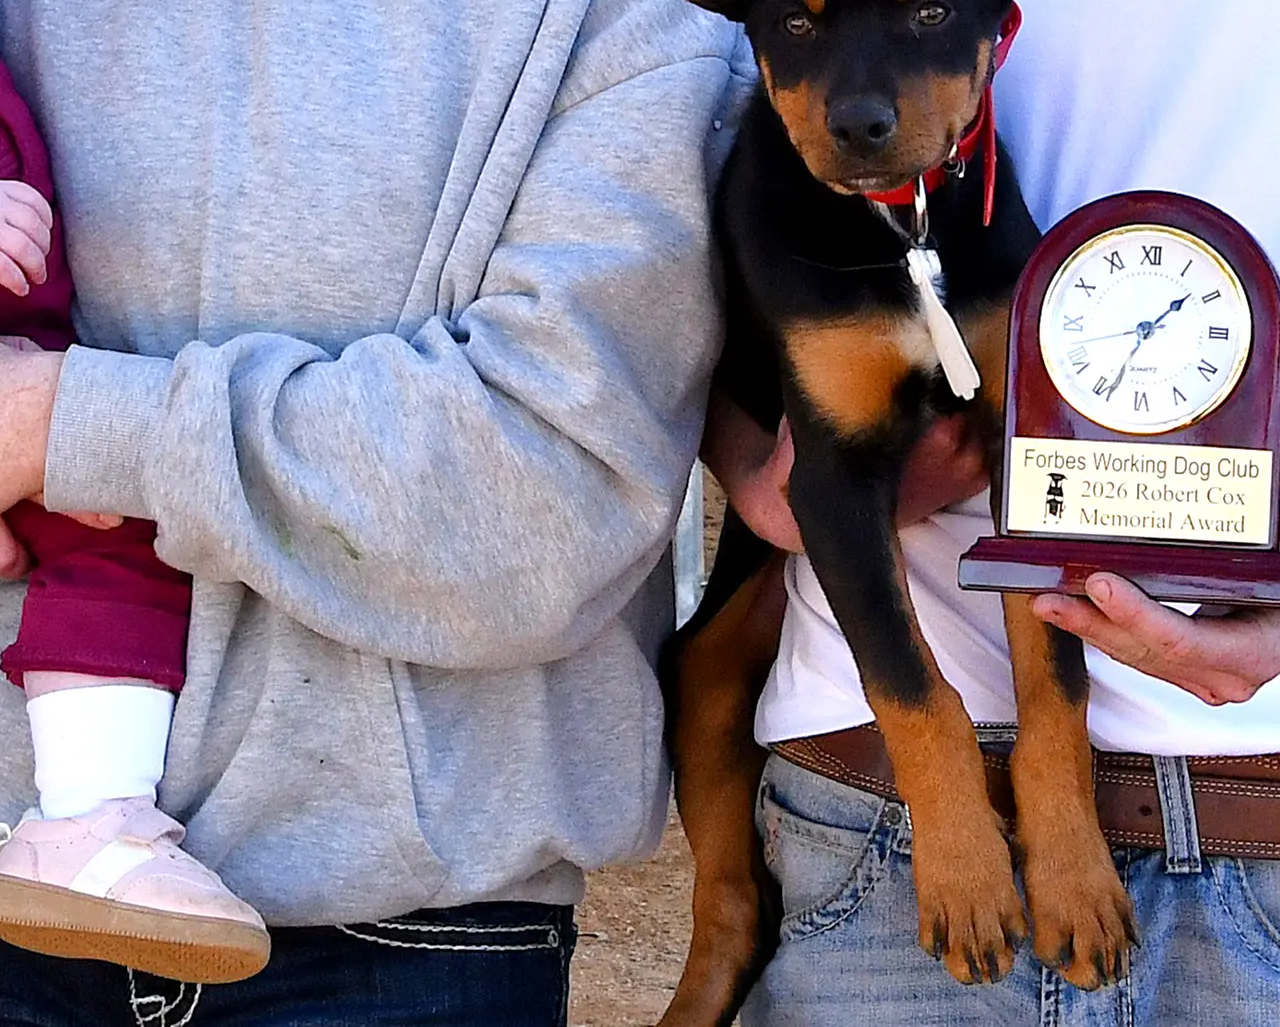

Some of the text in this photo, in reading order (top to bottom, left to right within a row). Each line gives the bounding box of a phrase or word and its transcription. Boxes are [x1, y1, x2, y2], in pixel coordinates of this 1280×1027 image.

[1103, 250, 1125, 274] XI
[1140, 245, 1163, 266] XII
[1180, 259, 1193, 277] I
[1074, 277, 1096, 297] X
[1201, 289, 1222, 304] II
[1063, 314, 1084, 332] IX
[1208, 326, 1229, 341] III
[1197, 359, 1218, 382] IV
[1133, 391, 1150, 412] VI
[1172, 386, 1187, 406] V
[1023, 449, 1260, 481] Forbes Working Dog Club
[1080, 480, 1246, 505] 2026 Robert Cox
[1079, 507, 1245, 533] Memorial Award
